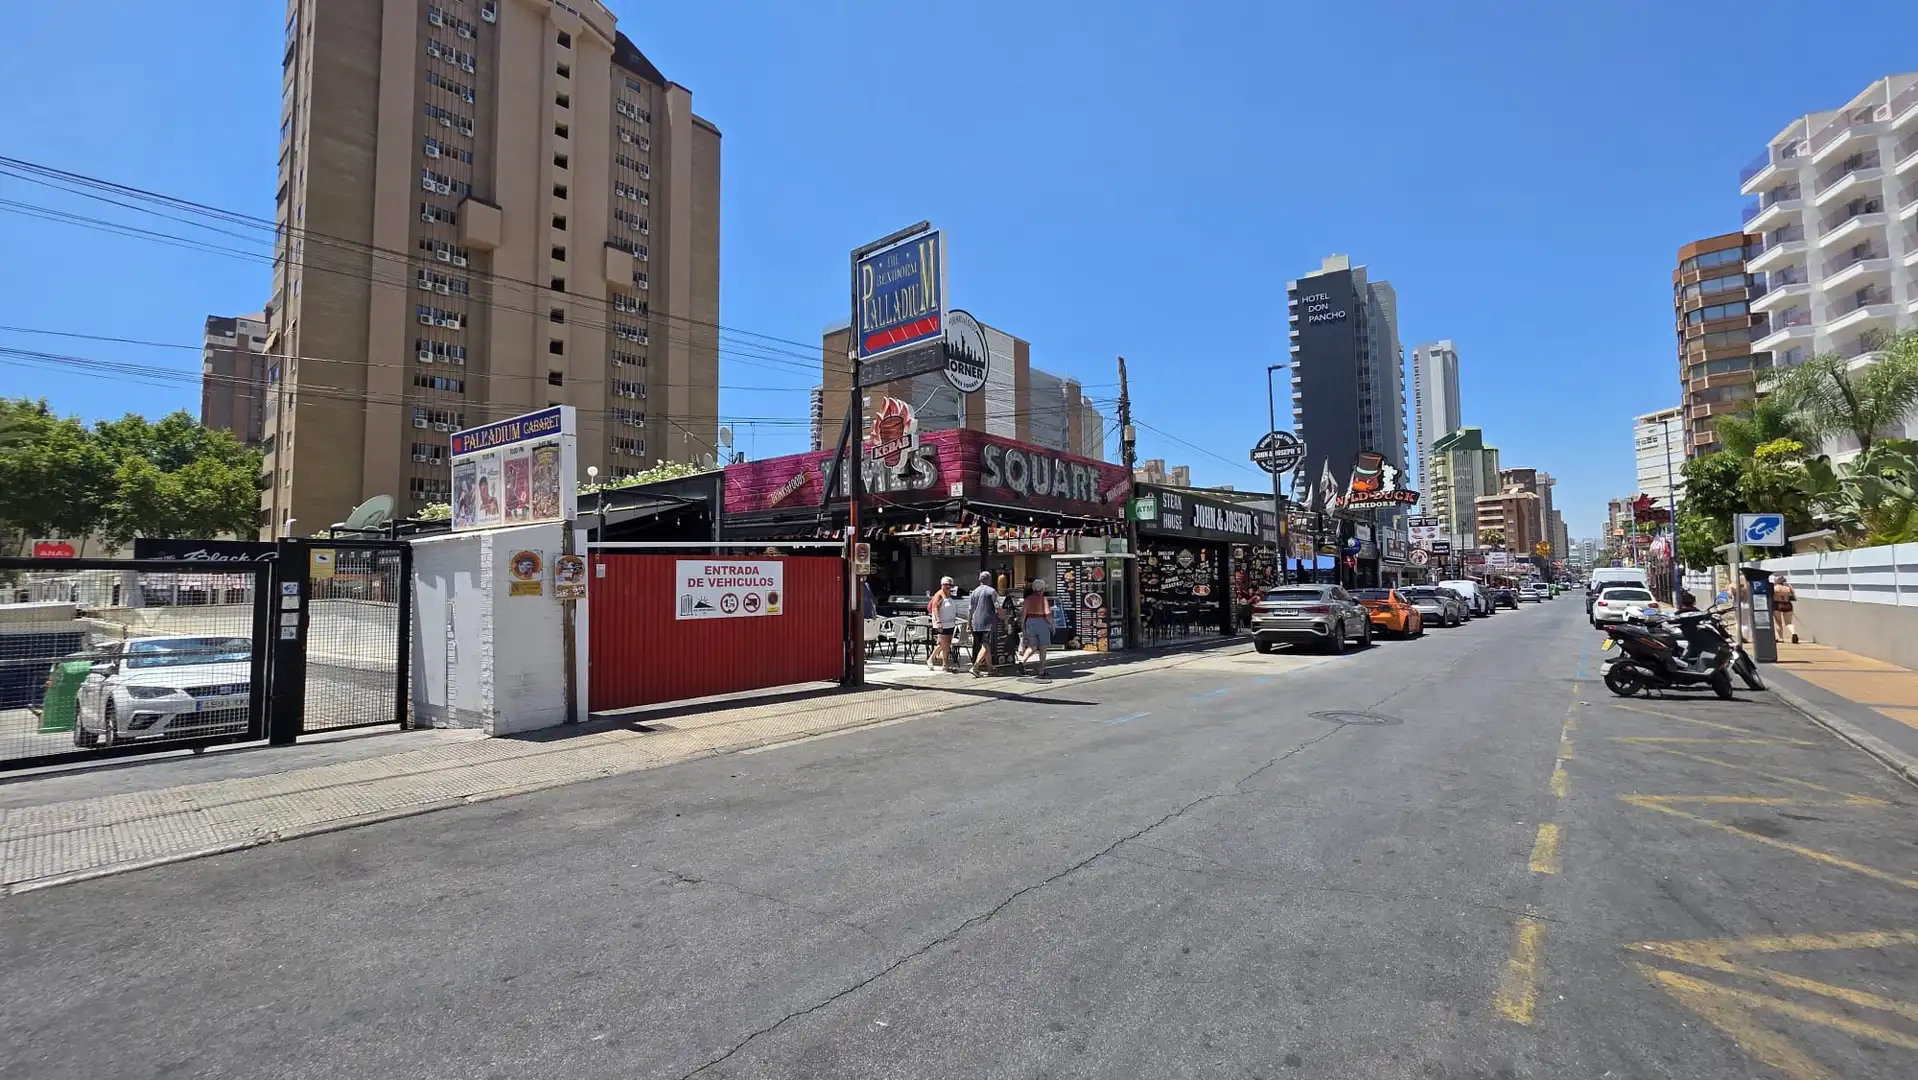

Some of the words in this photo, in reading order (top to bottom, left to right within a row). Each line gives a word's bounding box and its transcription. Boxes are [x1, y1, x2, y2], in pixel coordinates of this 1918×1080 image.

[863, 239, 939, 332] PALLADIUM
[1301, 292, 1330, 303] HOTEL
[1308, 303, 1328, 313] DON
[1308, 310, 1346, 323] PANCHO
[463, 422, 520, 451] PALLADIUM
[523, 414, 560, 434] CABARET
[875, 436, 909, 458] KEBAB
[1254, 451, 1268, 459] JOHN
[980, 443, 1100, 502] SQUARE
[1162, 492, 1182, 510] STEAK
[1349, 501, 1396, 509] BENIDORM
[1136, 505, 1154, 513] ATM
[1163, 513, 1182, 530] HOUSE
[1194, 504, 1216, 530] JOHN
[1216, 508, 1224, 531] &
[704, 566, 760, 575] ENTRADA
[688, 578, 704, 588] DE
[708, 577, 774, 587] VEHICULOS
[1753, 581, 1761, 590] P
[1110, 627, 1122, 636] ATM
